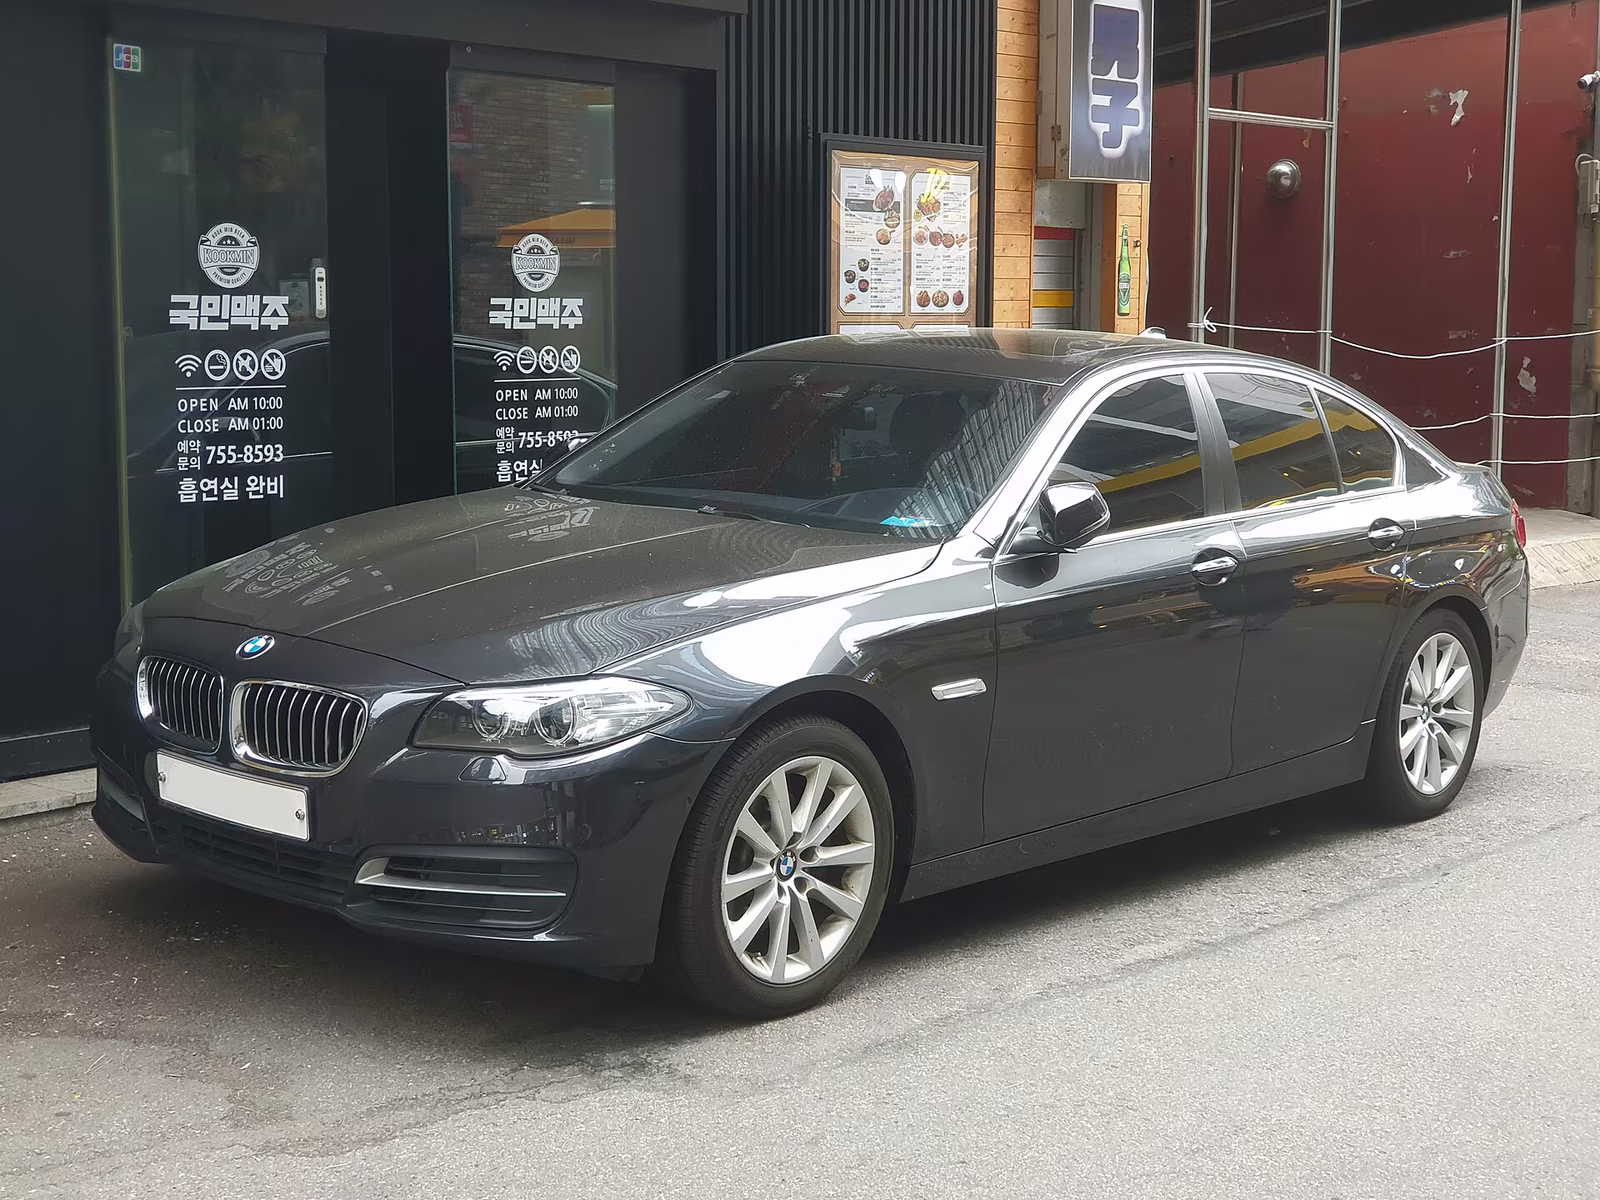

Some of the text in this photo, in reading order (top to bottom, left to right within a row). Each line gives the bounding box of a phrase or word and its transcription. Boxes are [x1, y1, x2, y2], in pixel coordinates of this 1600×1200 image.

[115, 53, 139, 63] JCB
[203, 247, 254, 264] KOOKMIN
[515, 255, 557, 271] KOOKMIN
[169, 294, 289, 331] 국민맥주
[489, 297, 583, 330] 국민맥주
[495, 387, 579, 402] OPEN AM 10:00
[177, 396, 284, 412] OPEN AM 10:00
[495, 405, 579, 420] CLOSE AM 01:00
[177, 416, 284, 433] CLOSE AM 01:00
[495, 426, 515, 440] 예약
[177, 440, 201, 454] 예약
[205, 443, 284, 465] 755-8593
[495, 441, 515, 454] 문의
[177, 456, 201, 470] 문의
[177, 474, 284, 503] 흡연실 완비
